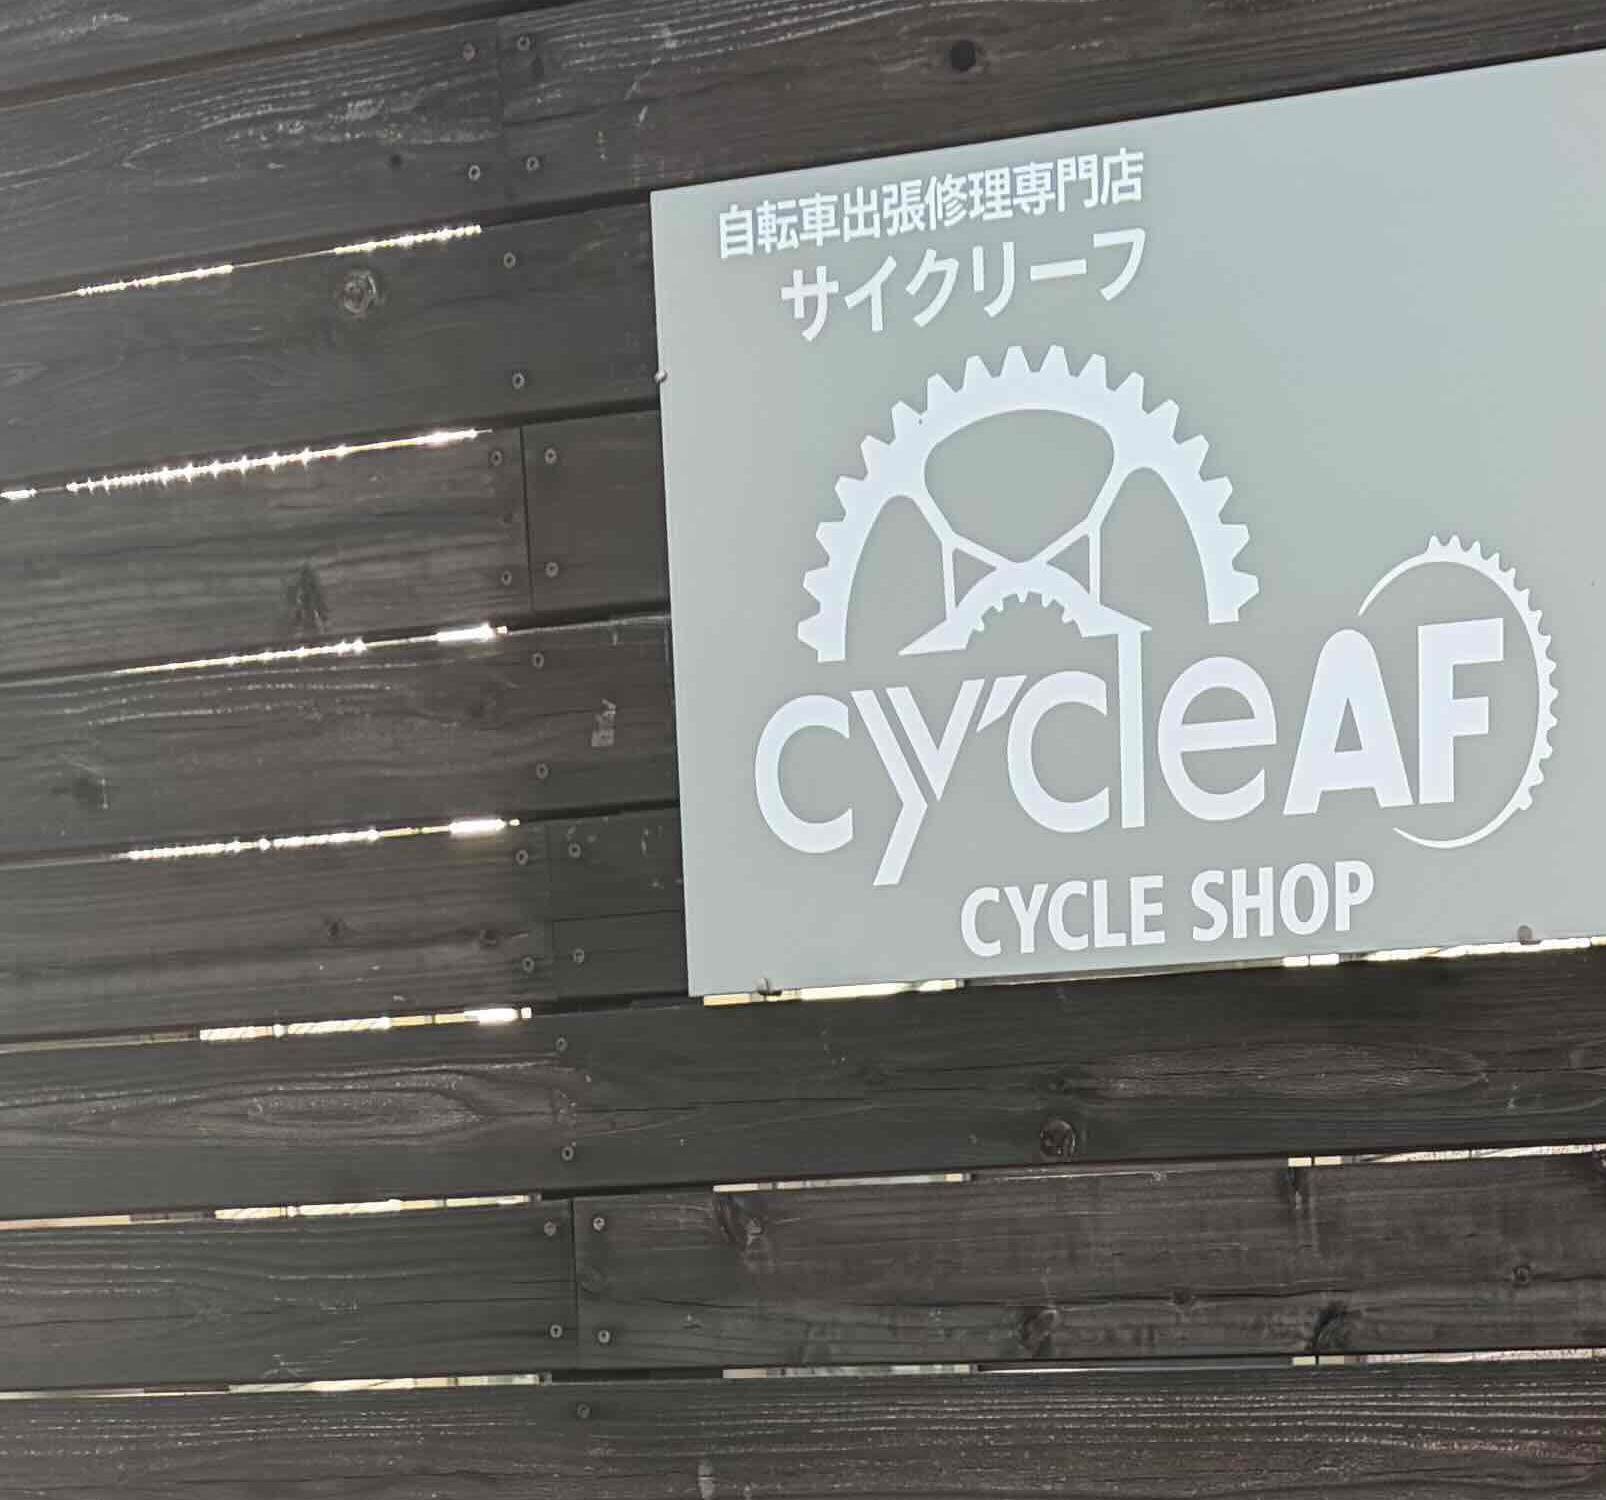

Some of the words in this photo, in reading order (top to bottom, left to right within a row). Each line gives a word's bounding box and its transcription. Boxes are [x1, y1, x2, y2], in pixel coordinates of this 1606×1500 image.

[718, 147, 1145, 260] 自転車出張修理専門店
[780, 226, 1148, 342] サイクリーフ
[960, 875, 1166, 958] CYCLE
[1190, 860, 1375, 942] SHOP
